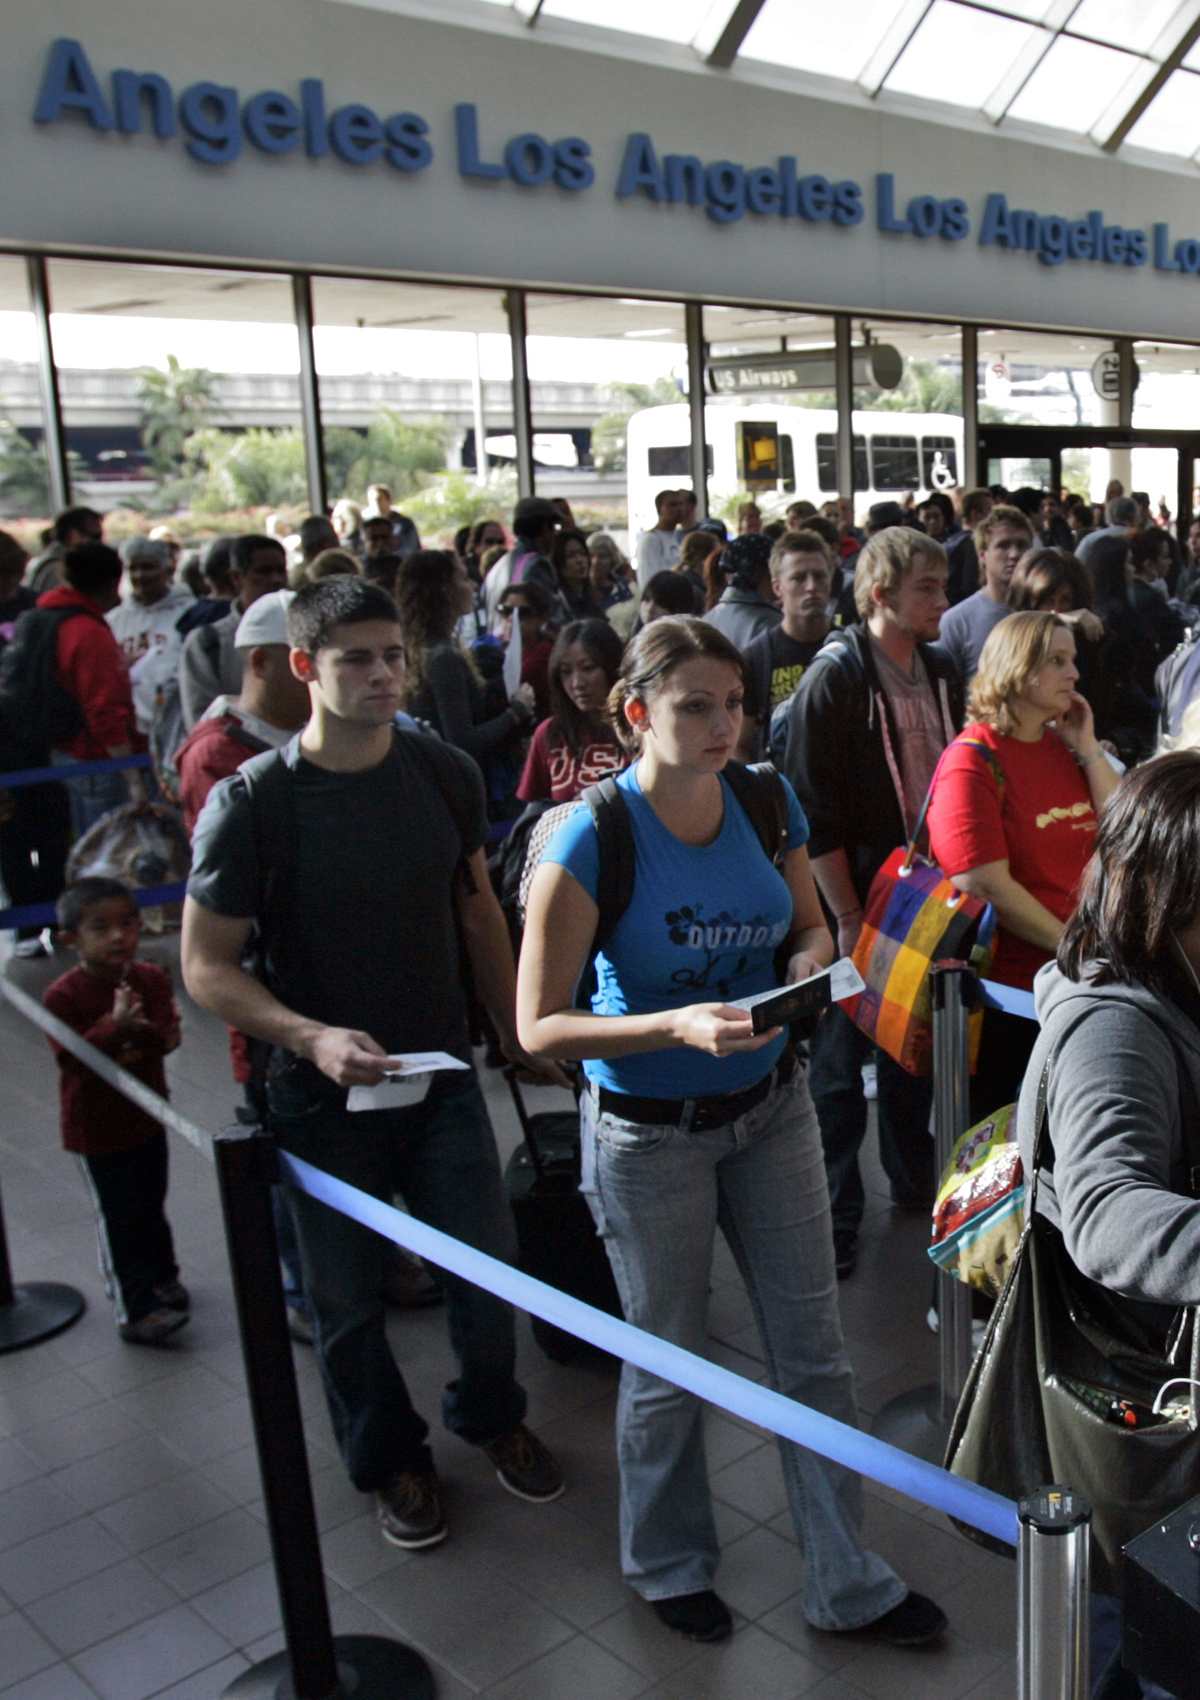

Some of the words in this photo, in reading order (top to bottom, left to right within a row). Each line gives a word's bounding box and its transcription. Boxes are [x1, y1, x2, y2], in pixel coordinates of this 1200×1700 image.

[34, 37, 433, 164] Angeles
[455, 103, 595, 191] Los
[616, 132, 863, 223] Angeles
[877, 173, 969, 239] Los
[978, 192, 1146, 266] Angeles
[715, 370, 735, 388] US
[739, 368, 798, 388] Airways
[547, 744, 625, 791] US
